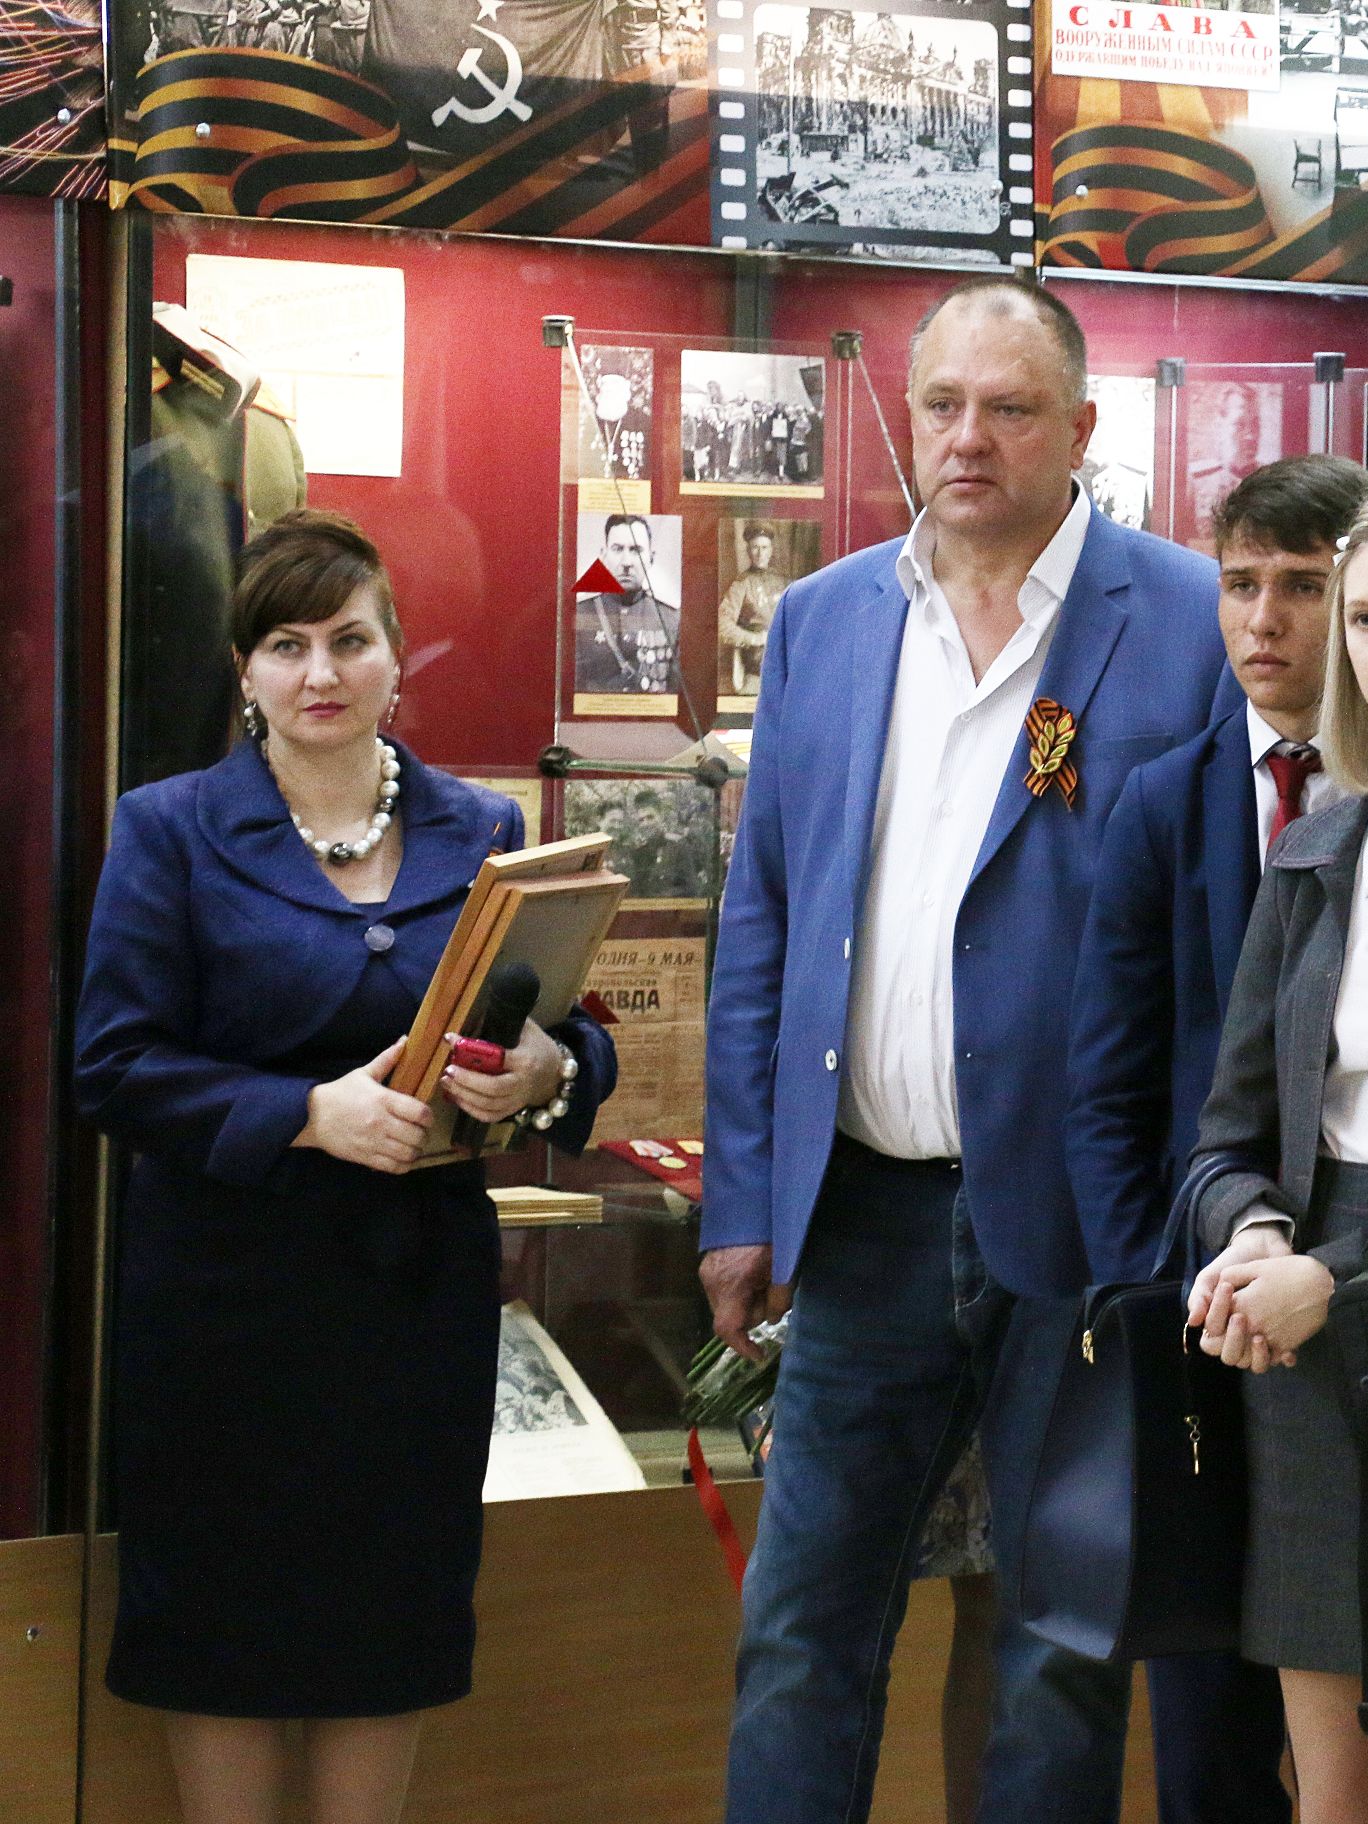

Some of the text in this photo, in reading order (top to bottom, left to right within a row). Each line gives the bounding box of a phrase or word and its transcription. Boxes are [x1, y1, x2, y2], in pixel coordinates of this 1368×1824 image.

[1069, 5, 1258, 39] СЛАВА
[1055, 28, 1273, 61] ВООРУЖЕННЫМ СИЛАМ СССР
[596, 952, 638, 966] ОДНЯ
[647, 951, 656, 966] 9
[660, 951, 695, 966] МАЯ
[602, 989, 660, 1014] АВДА
